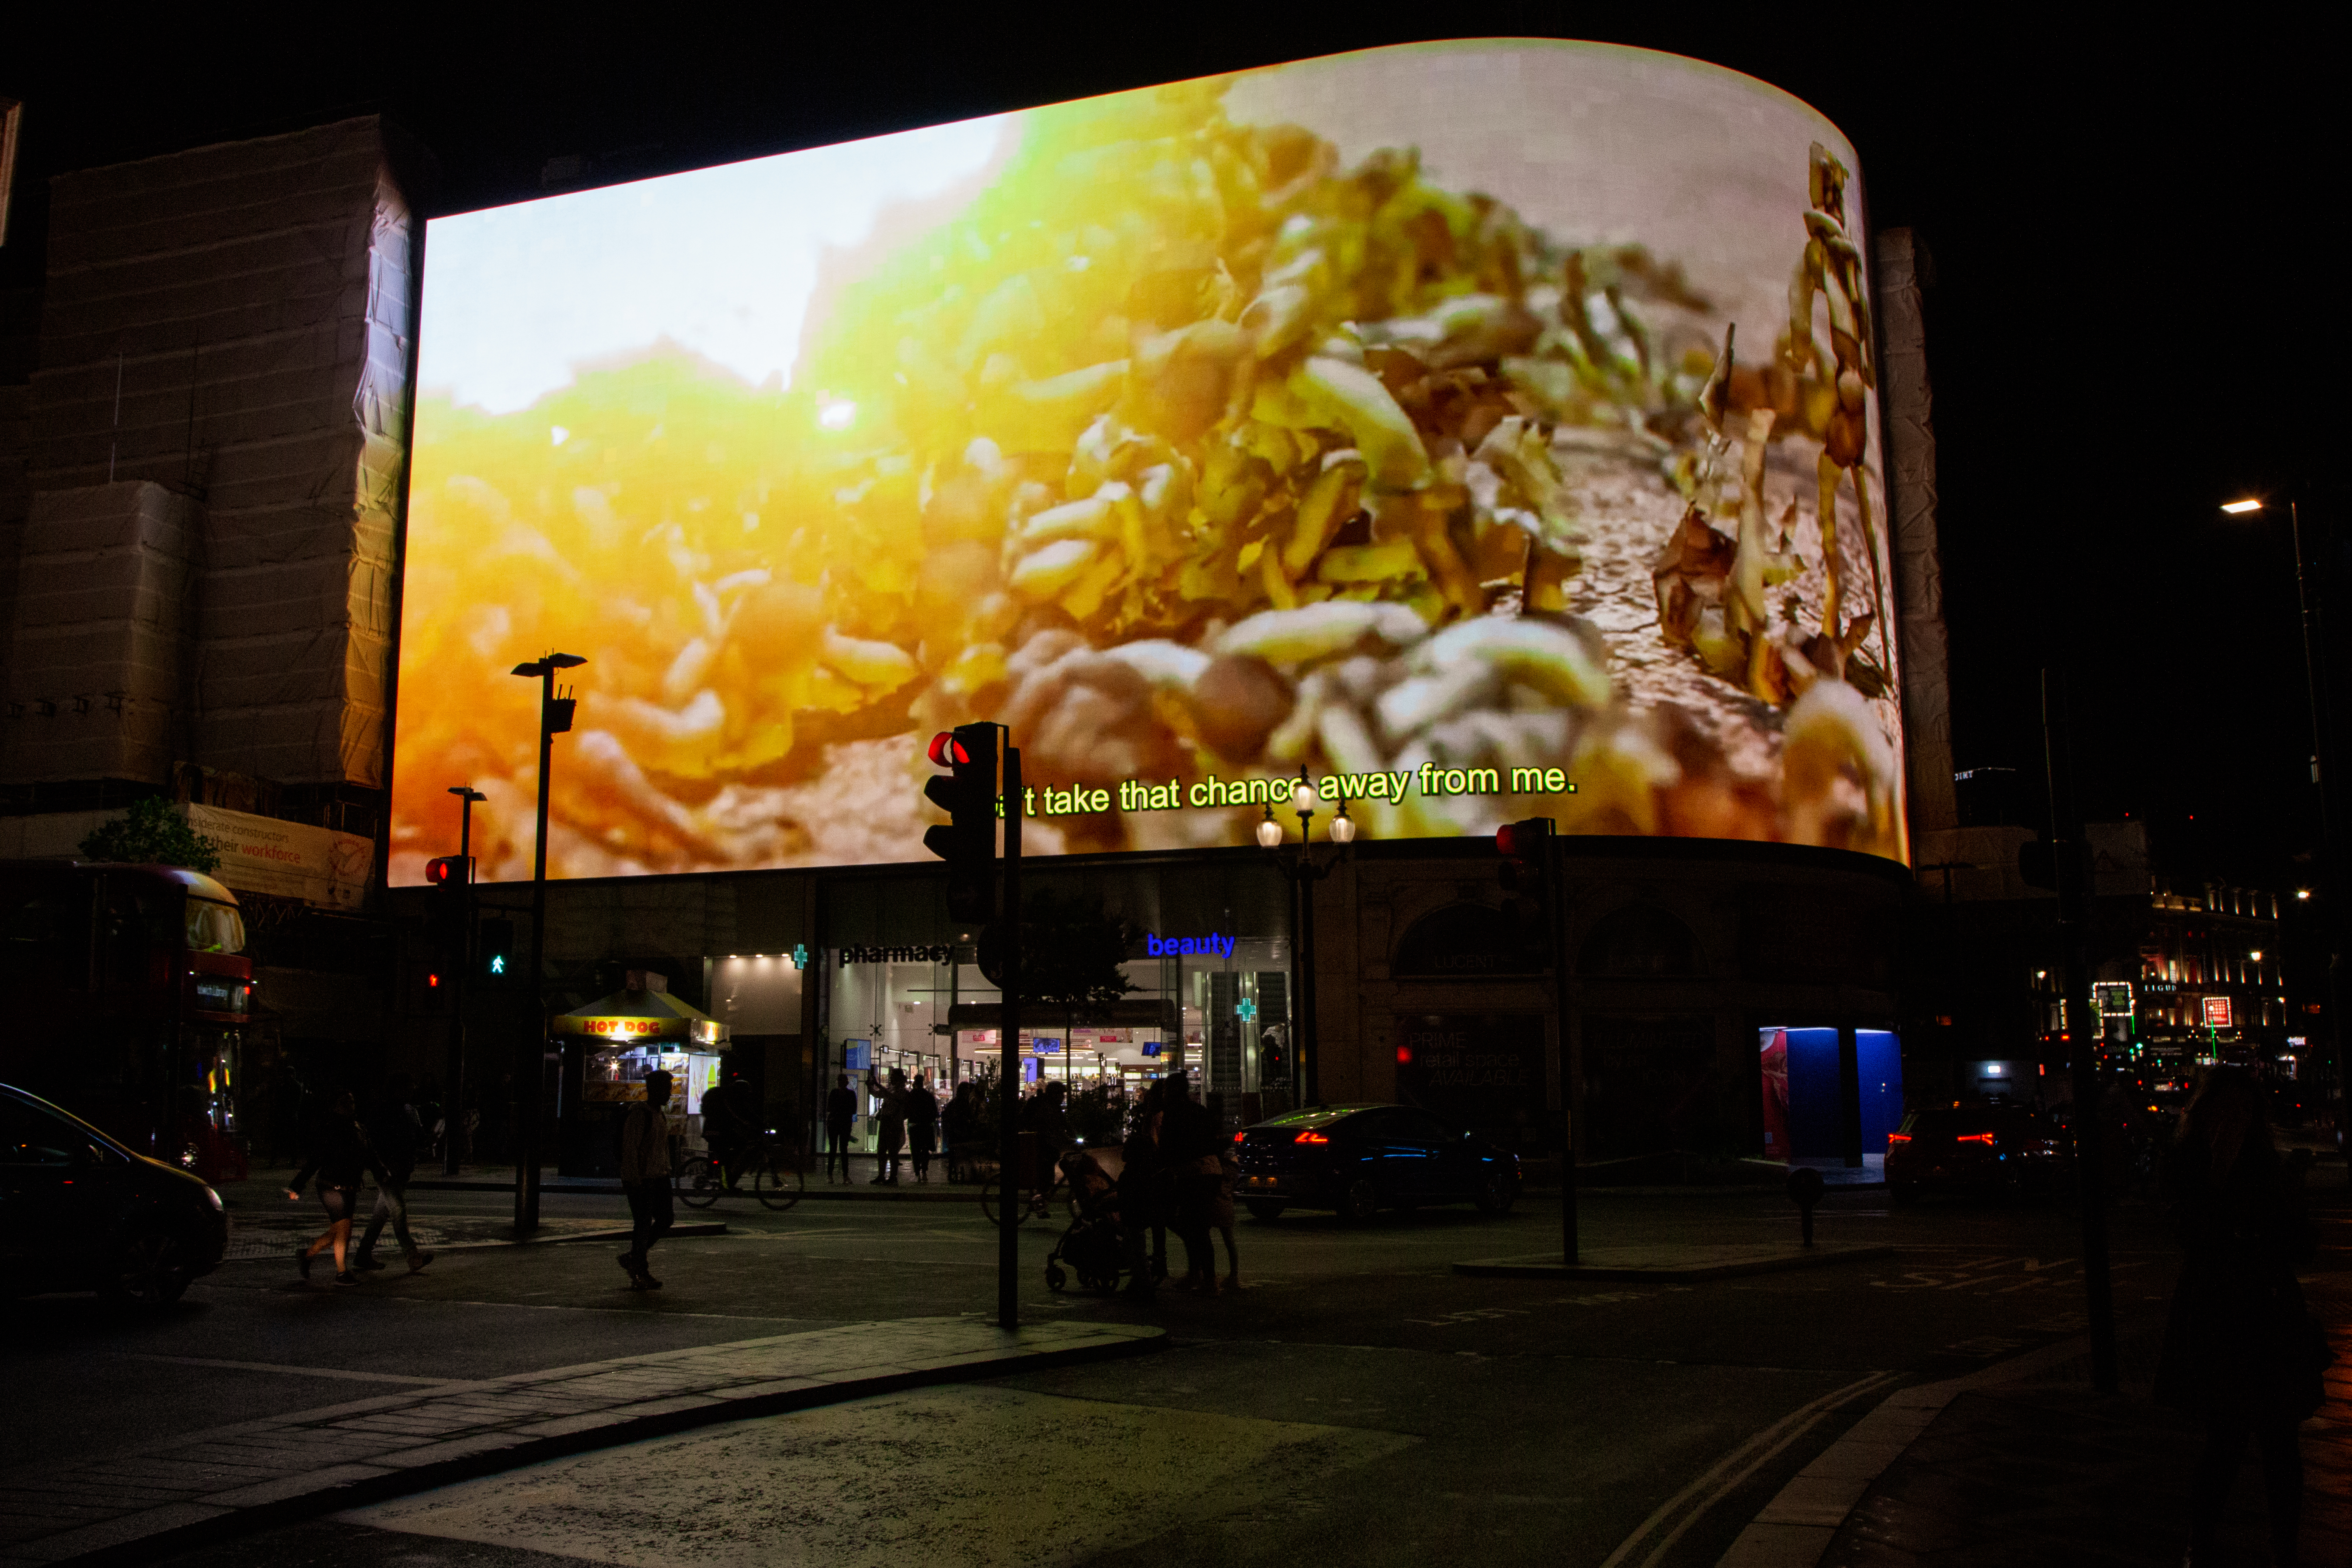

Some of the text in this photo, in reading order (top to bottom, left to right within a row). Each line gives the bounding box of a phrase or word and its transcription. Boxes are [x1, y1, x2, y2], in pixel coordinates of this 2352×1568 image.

[1043, 783, 1110, 815] take
[1119, 778, 1181, 810] that
[1318, 770, 1411, 804] away
[1418, 762, 1500, 794] from
[1511, 767, 1577, 792] me.
[181, 816, 289, 843] onsiderate constructors
[241, 843, 301, 864] workforce
[839, 943, 956, 968] pharmacy
[1147, 932, 1235, 959] beauty
[1433, 954, 1497, 969] LUCENT
[584, 1020, 660, 1034] HOT DOG
[1409, 1032, 1468, 1049] PRIME
[1419, 1051, 1520, 1070] retail space
[1428, 1068, 1531, 1087] AVAILABLE
